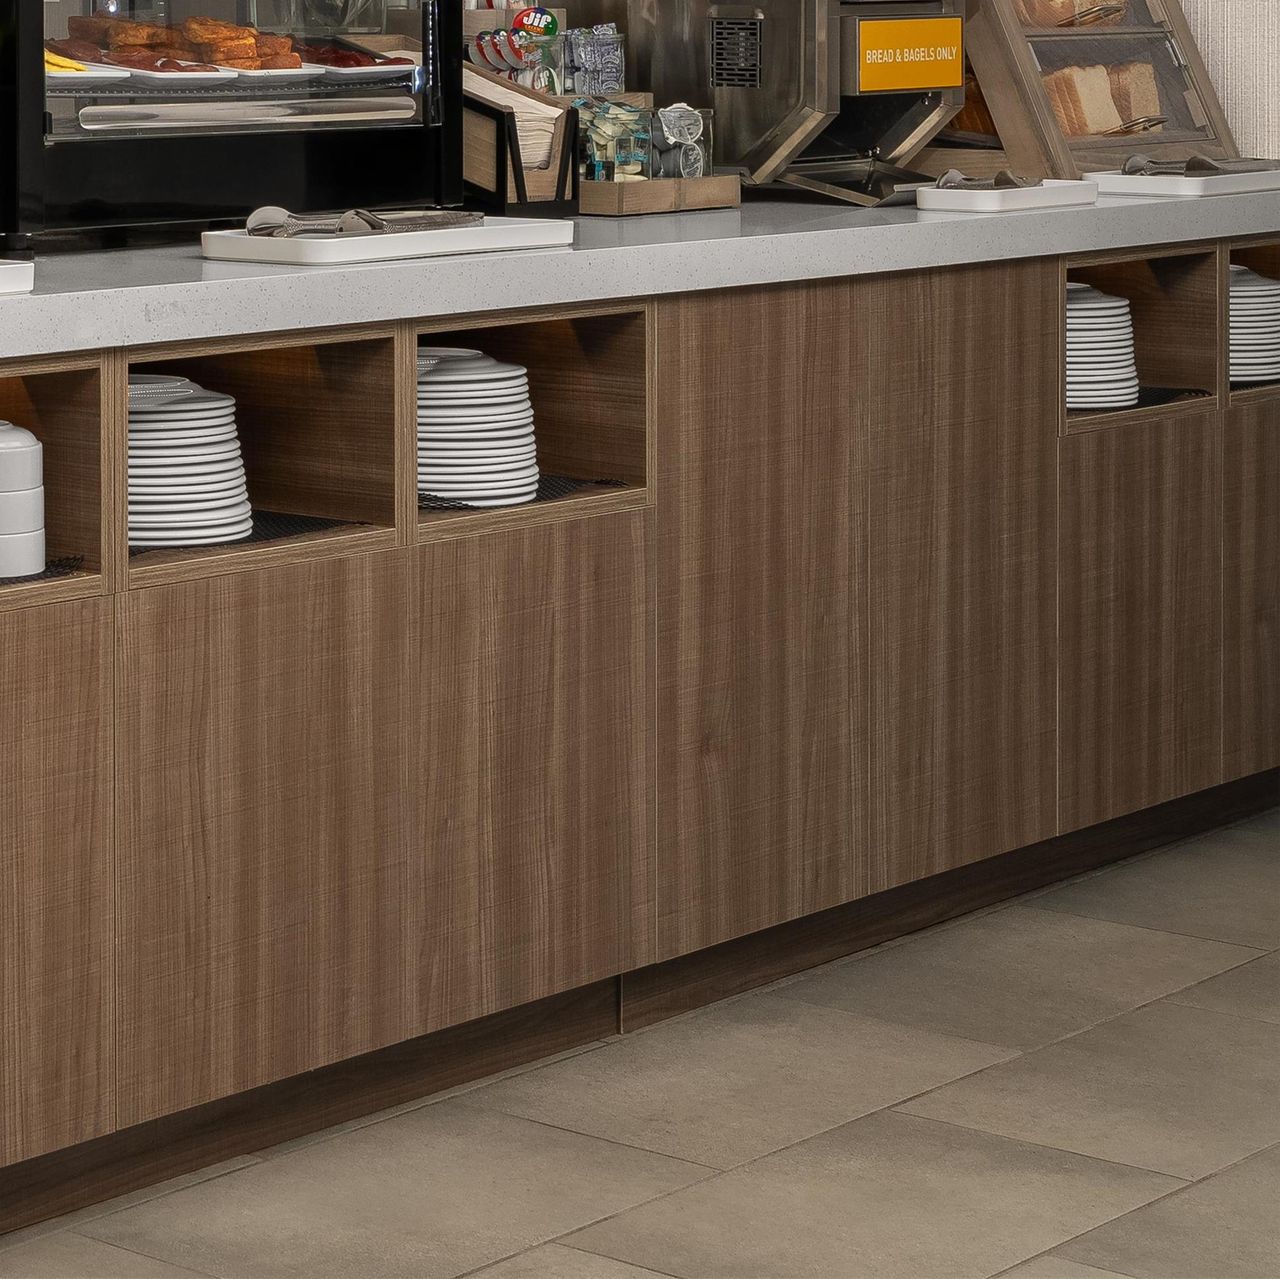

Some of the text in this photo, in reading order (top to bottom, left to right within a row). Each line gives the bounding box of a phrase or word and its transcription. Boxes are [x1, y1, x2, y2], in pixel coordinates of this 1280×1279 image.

[522, 12, 552, 28] Jif
[866, 46, 957, 64] BREAD & BAGELS ONLY
